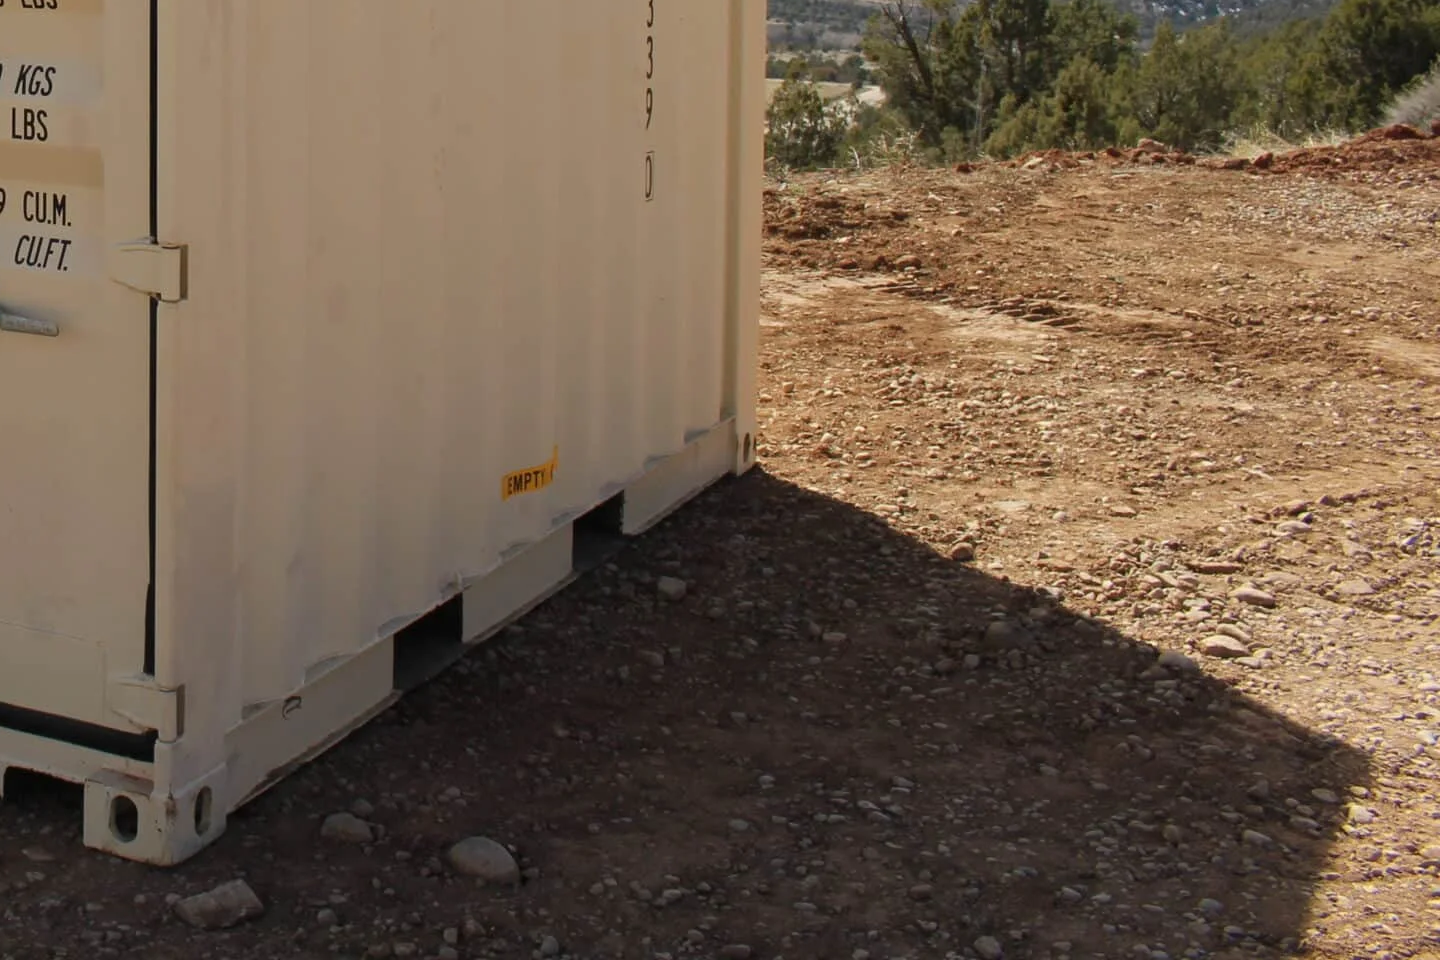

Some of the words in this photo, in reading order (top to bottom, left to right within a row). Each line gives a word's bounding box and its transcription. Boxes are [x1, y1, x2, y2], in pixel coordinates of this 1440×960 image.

[14, 64, 56, 96] KGS
[11, 107, 48, 142] LBS
[22, 190, 72, 227] CU.M.
[14, 235, 72, 272] CU.FT.
